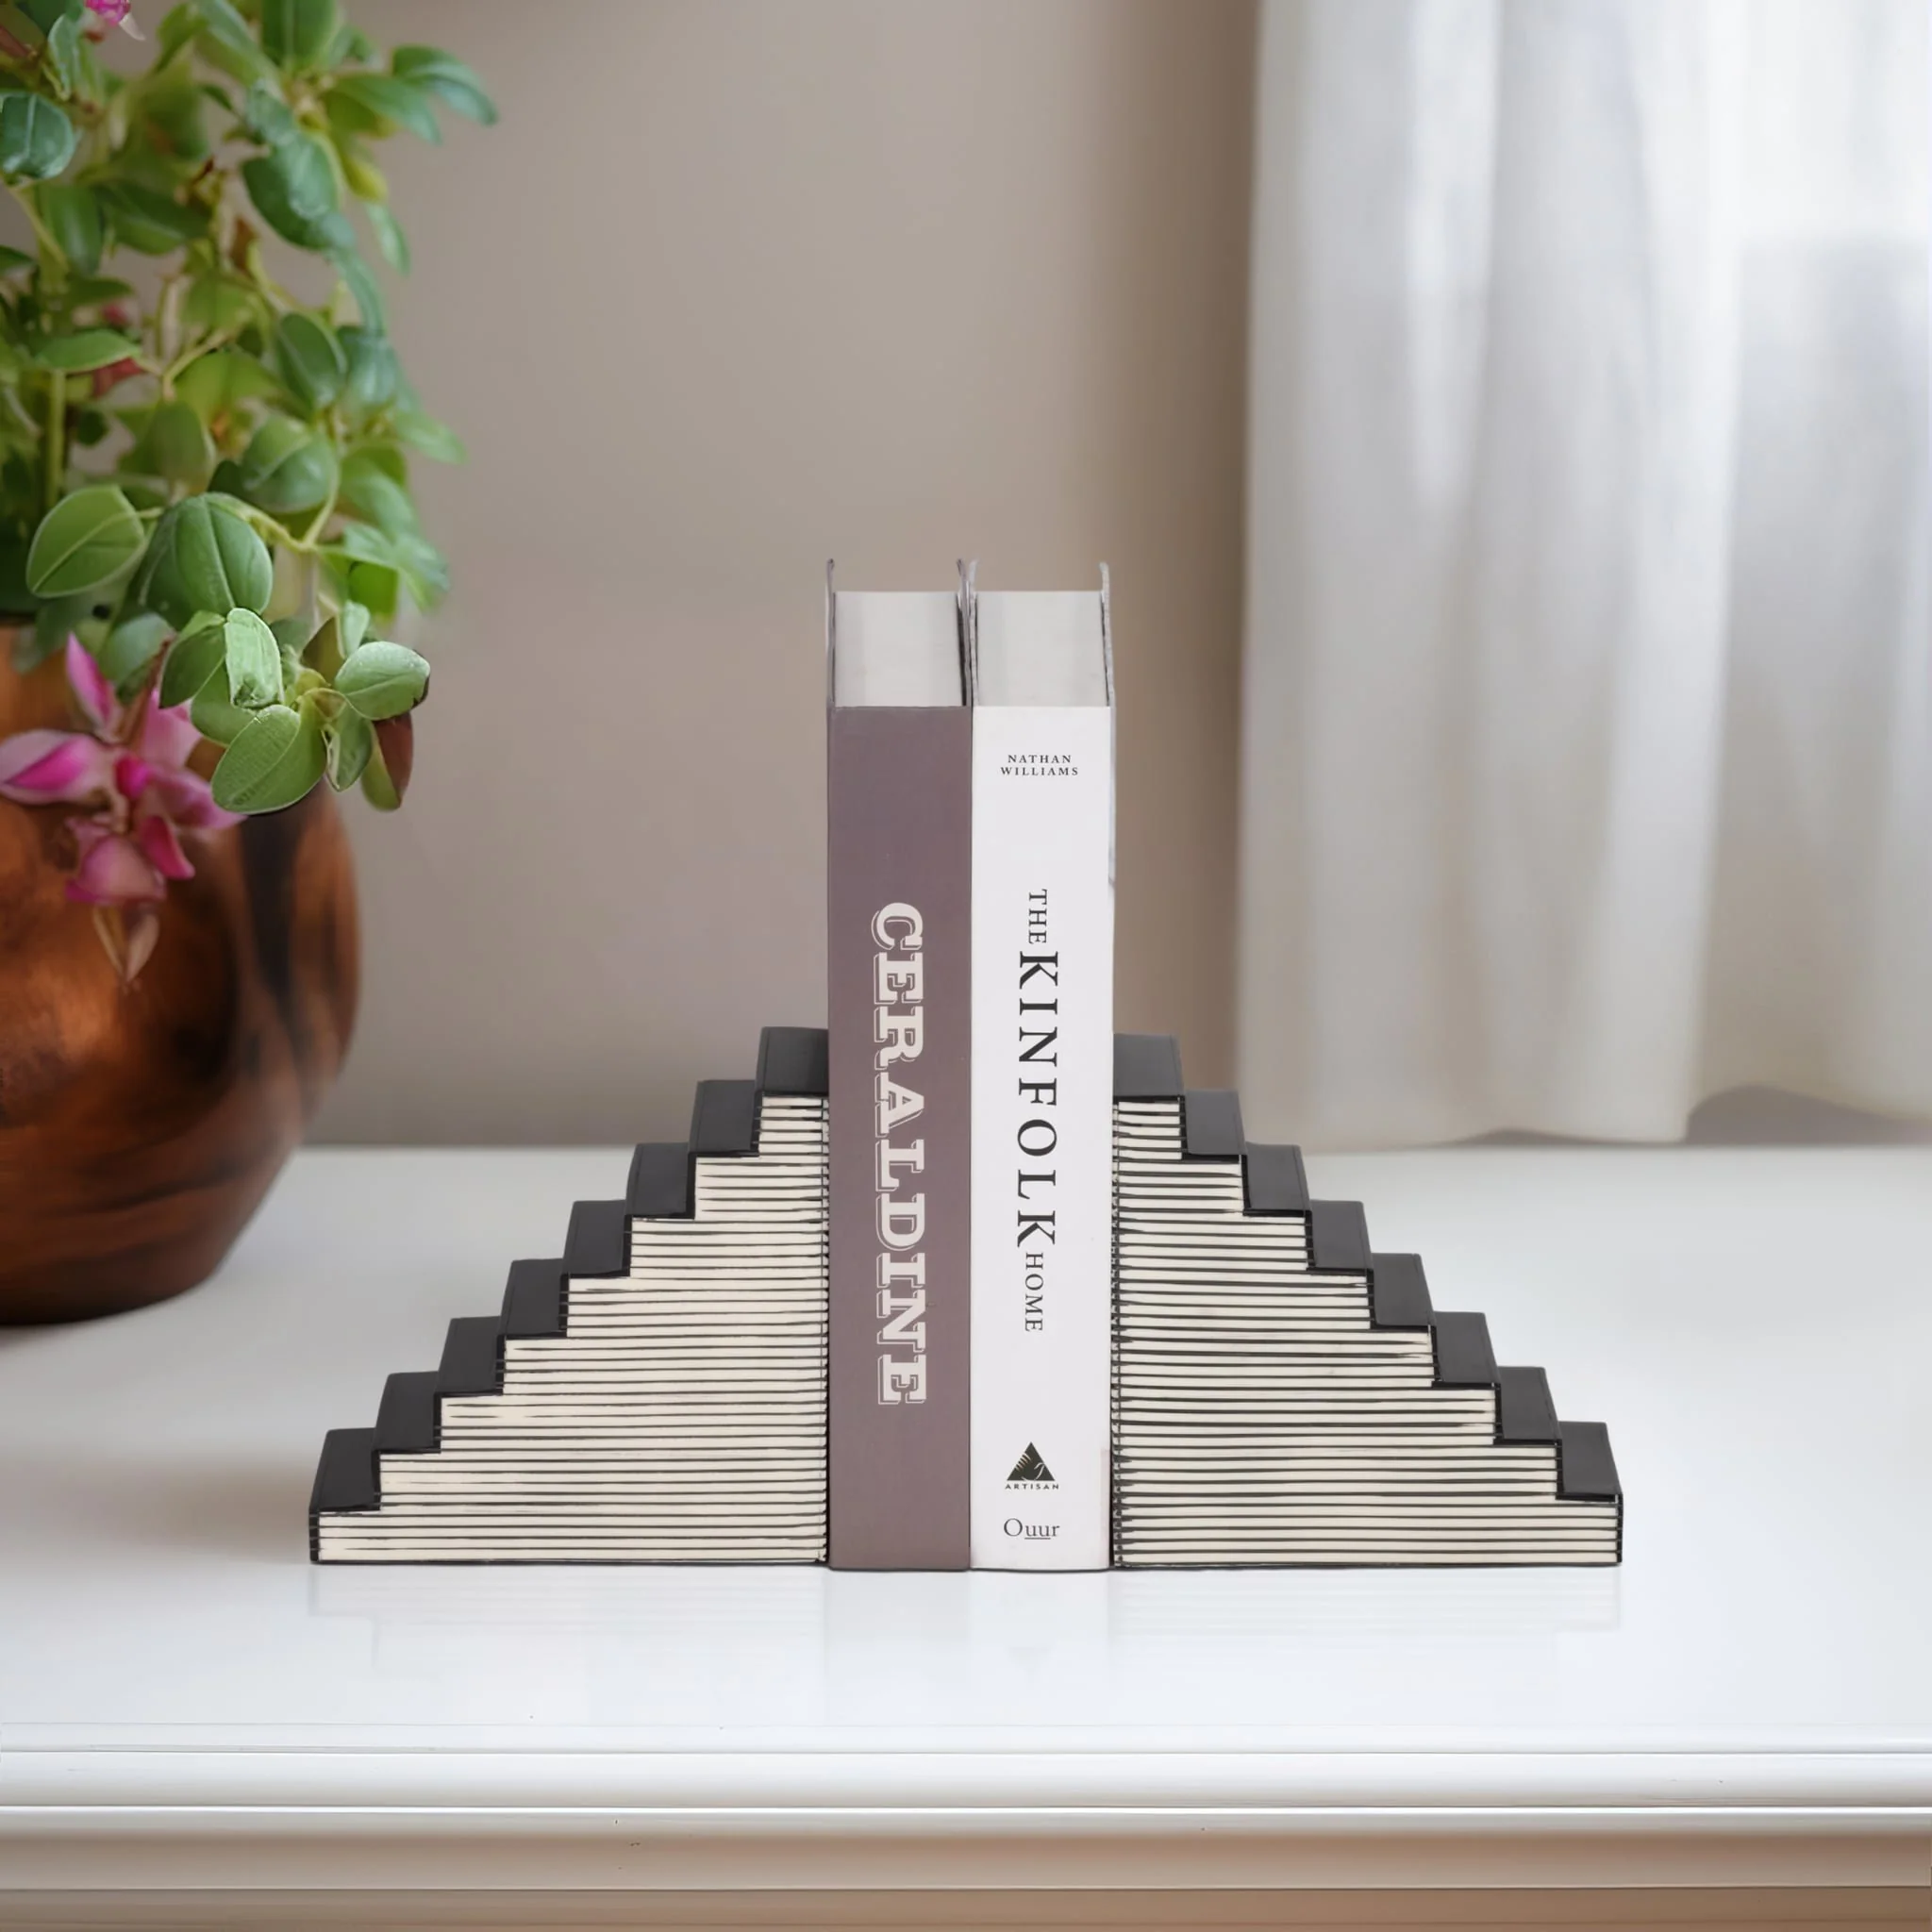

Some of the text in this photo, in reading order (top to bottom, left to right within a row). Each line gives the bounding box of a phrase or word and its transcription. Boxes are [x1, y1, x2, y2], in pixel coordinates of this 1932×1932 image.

[1008, 754, 1073, 764] NATHAN
[1000, 766, 1079, 776] WILLIAMS
[1017, 888, 1058, 1332] THE KINFOLK HOME
[1003, 1517, 1060, 1541] Ouur
